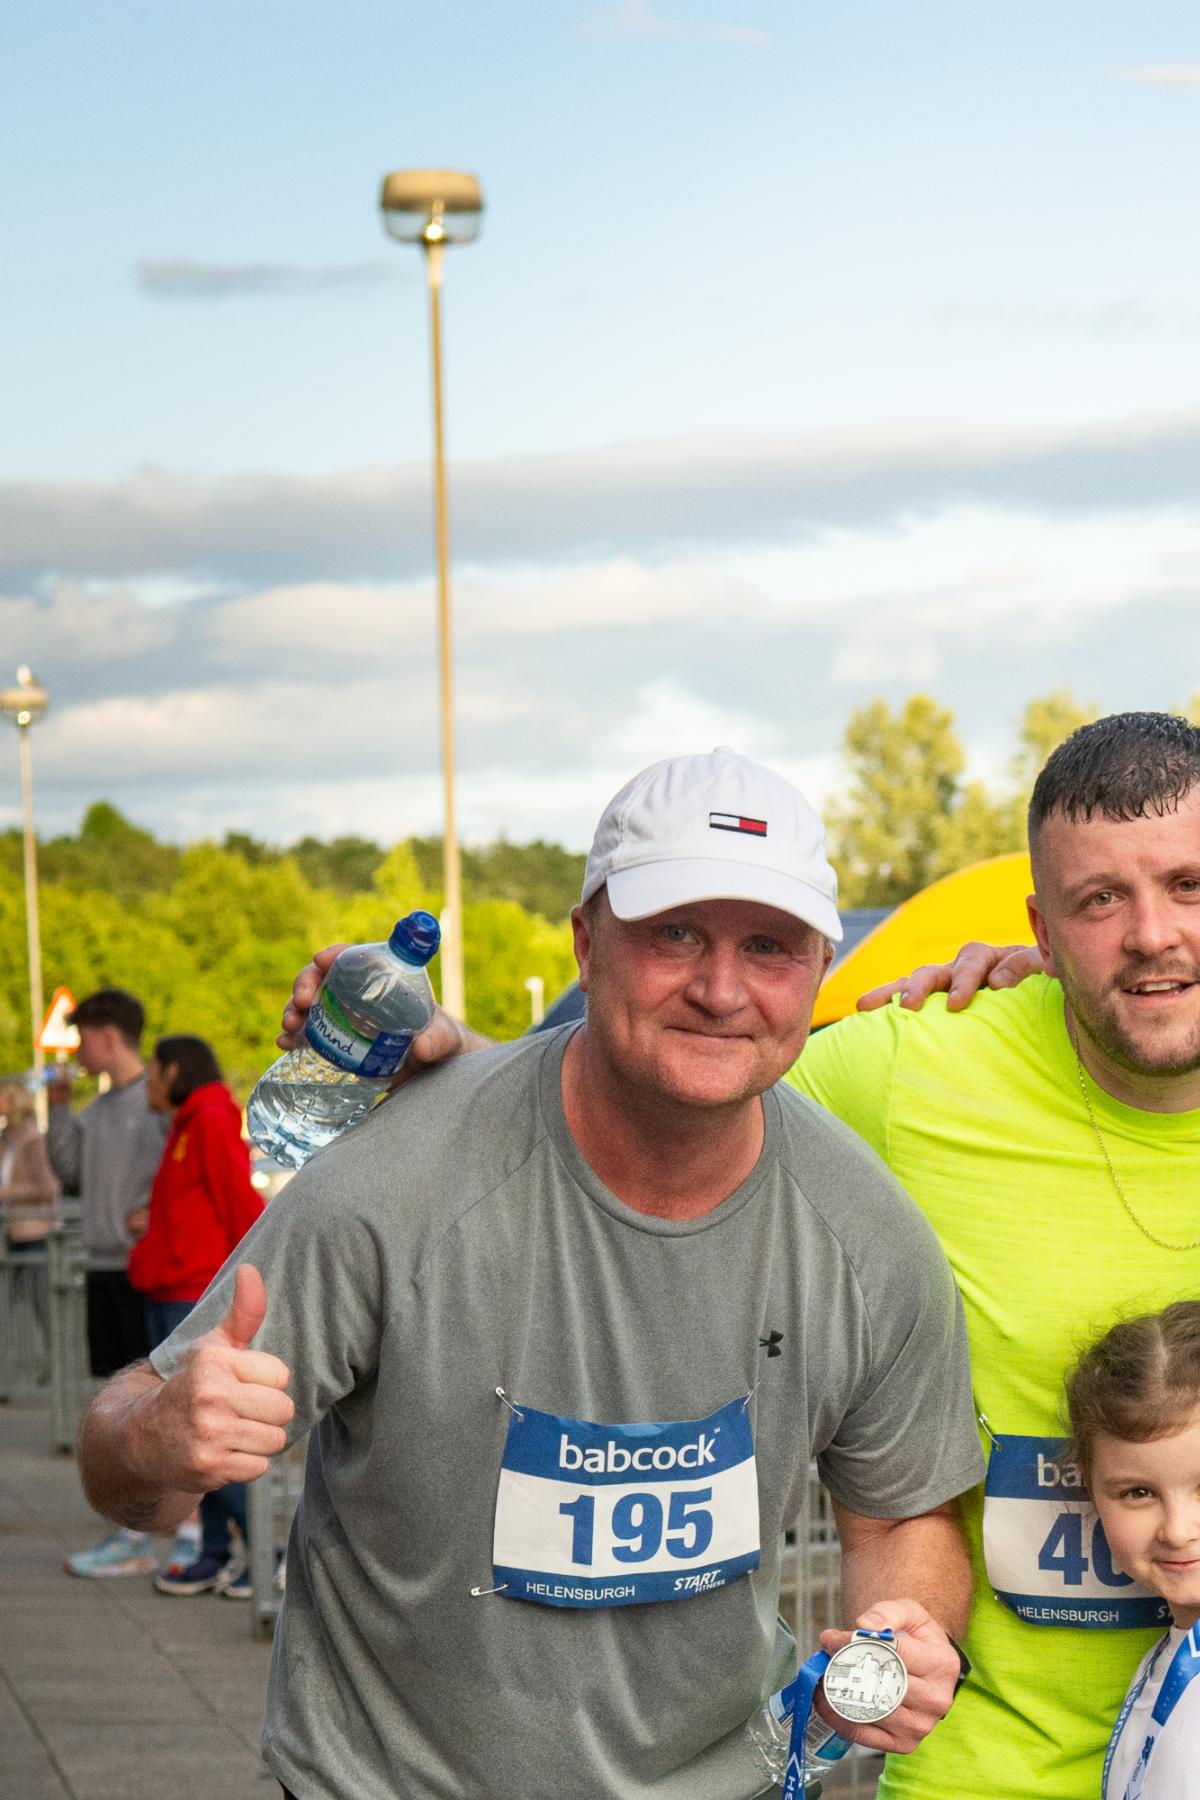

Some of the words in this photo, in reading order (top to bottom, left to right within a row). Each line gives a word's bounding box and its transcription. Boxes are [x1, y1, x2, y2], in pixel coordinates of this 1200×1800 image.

[559, 1434, 716, 1473] babcock
[559, 1487, 714, 1565] 195
[526, 1582, 636, 1600] HELENSBURGH
[674, 1569, 721, 1591] START
[1017, 1605, 1120, 1623] HELENSBURGH
